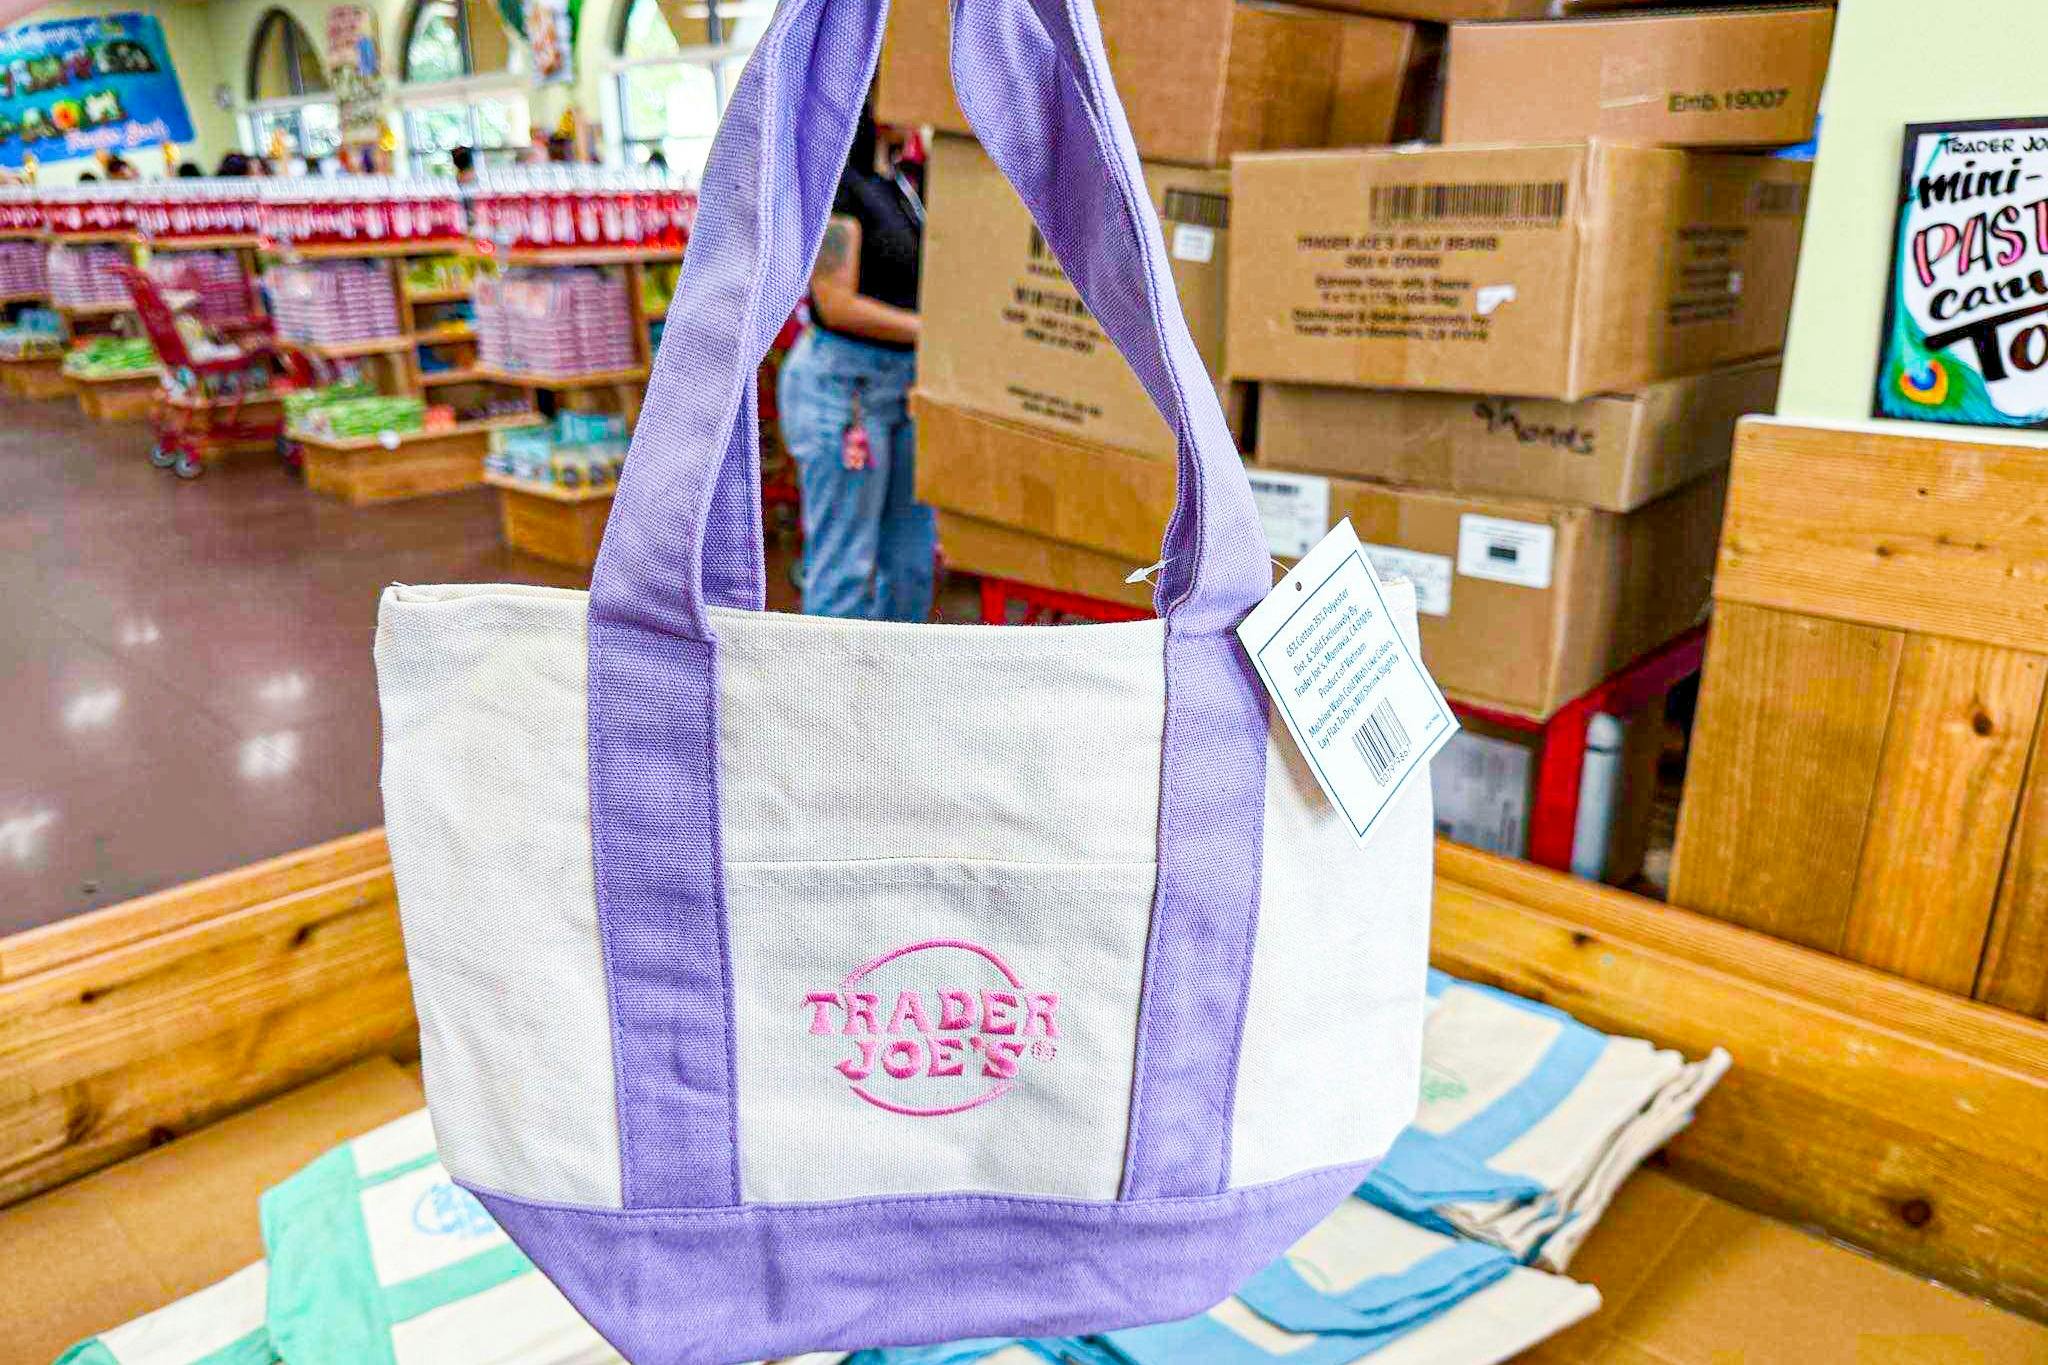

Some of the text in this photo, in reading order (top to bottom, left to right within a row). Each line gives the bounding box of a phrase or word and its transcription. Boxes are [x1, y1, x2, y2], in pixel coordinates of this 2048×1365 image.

[1939, 137, 2014, 155] TRADER
[1918, 158, 2042, 210] mini-
[1295, 622, 1316, 647] Cotton
[1322, 586, 1350, 619] Polyester
[1309, 638, 1324, 658] Sold
[1320, 611, 1352, 647] Exclusively
[1294, 675, 1313, 698] Trader
[1348, 622, 1359, 637] CA
[1318, 640, 1367, 699] Product of Vietnam
[1307, 707, 1332, 738] Machine
[1328, 692, 1346, 713] Wash
[1342, 678, 1357, 697] Cold
[1352, 665, 1369, 685] With
[1317, 733, 1331, 751] Lay
[1326, 721, 1340, 739] Flat
[1336, 714, 1346, 726] To
[801, 987, 1061, 1038] TRADER
[834, 1035, 1025, 1081] JOE'S
